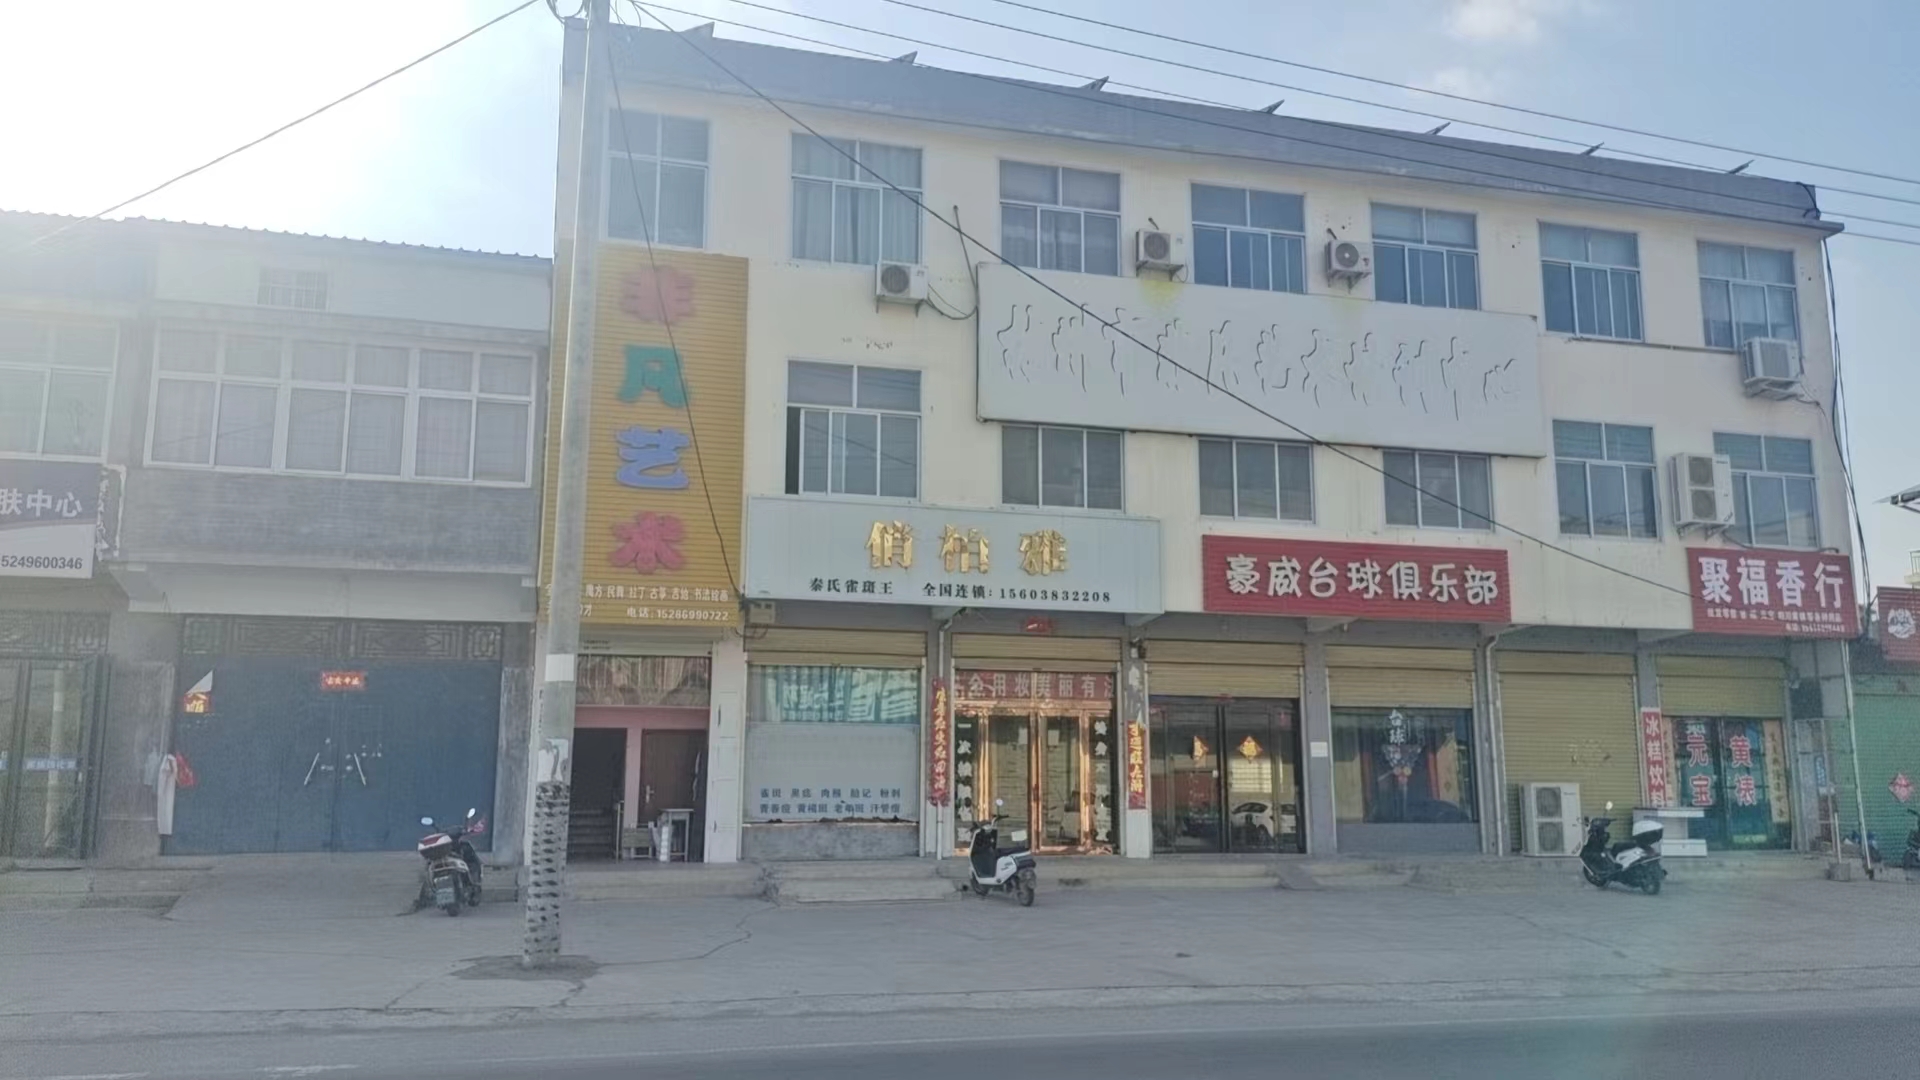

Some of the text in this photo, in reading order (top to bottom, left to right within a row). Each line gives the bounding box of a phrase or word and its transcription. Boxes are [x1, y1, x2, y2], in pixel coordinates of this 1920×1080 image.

[1225, 553, 1500, 606] 豪威台球俱乐部
[1698, 556, 1844, 609] 聚福香行
[1686, 734, 1714, 807] 元宝
